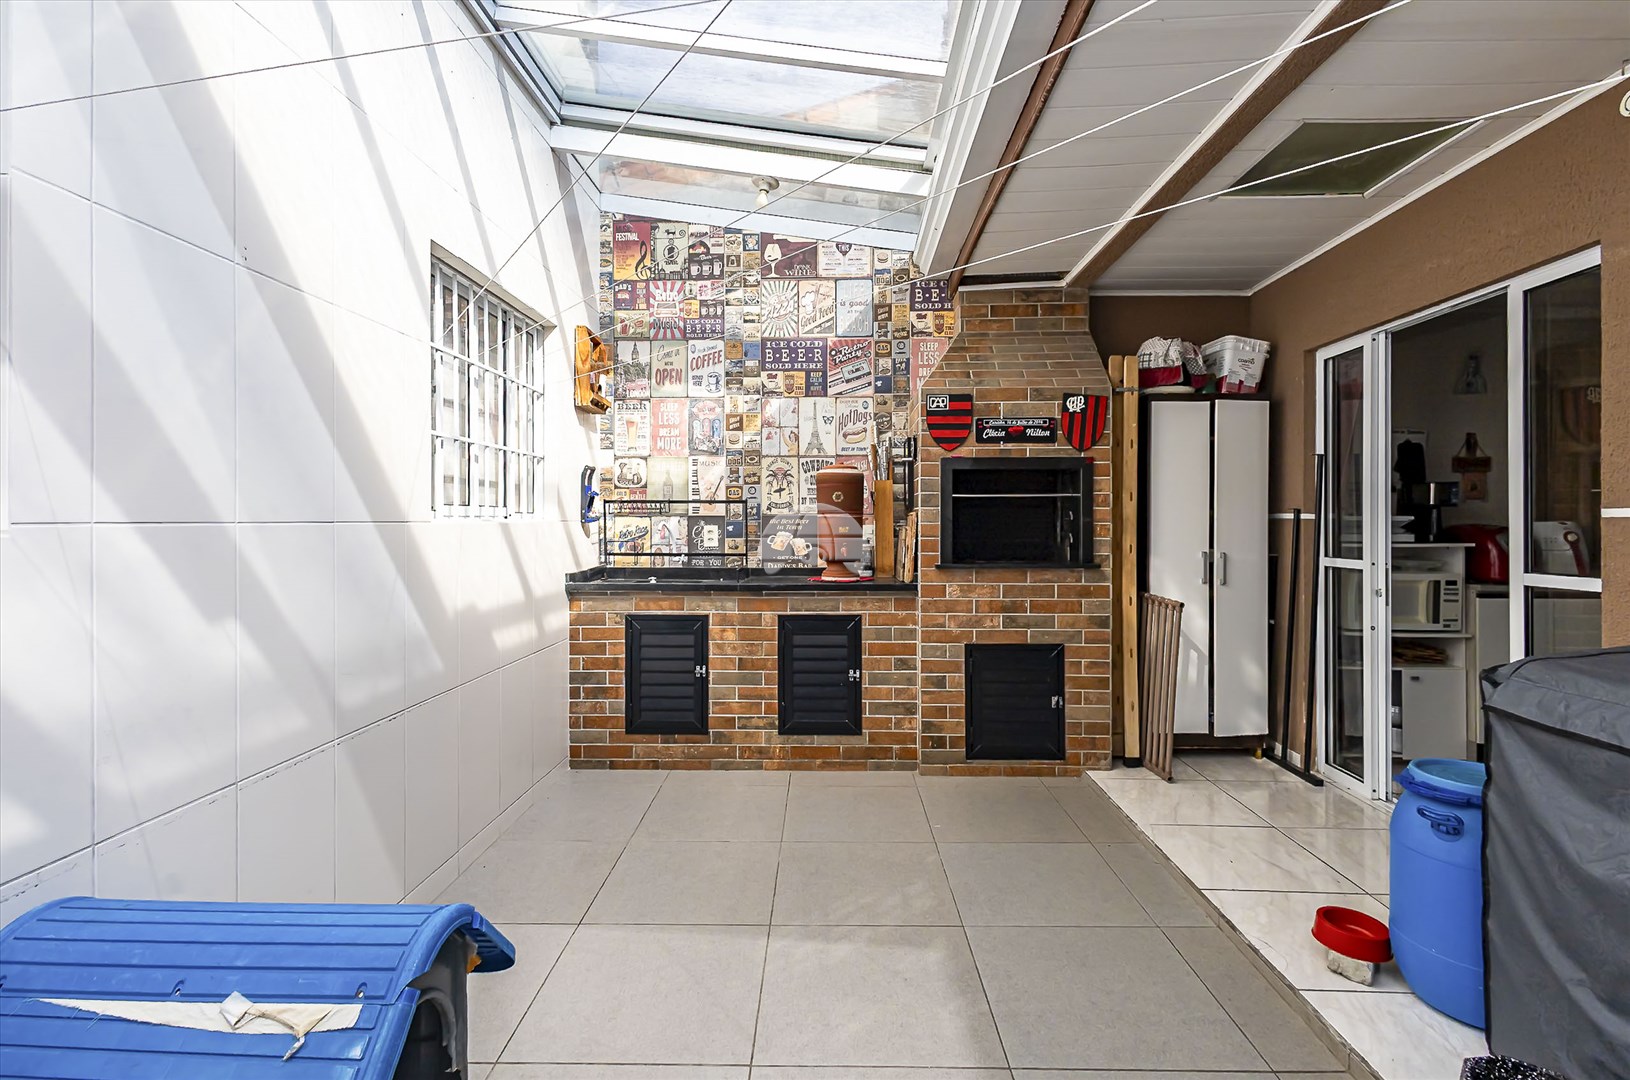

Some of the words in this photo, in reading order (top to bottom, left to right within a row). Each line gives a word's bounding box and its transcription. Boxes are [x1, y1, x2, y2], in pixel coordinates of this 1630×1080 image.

[615, 232, 640, 241] FESTIVAL
[914, 280, 937, 288] ICE
[766, 340, 788, 348] ICE
[790, 340, 823, 348] COLD
[839, 340, 870, 355] Retro
[919, 342, 940, 351] SLEEP
[689, 349, 723, 372] COFFEE
[833, 349, 864, 364] Party
[918, 352, 940, 365] LESS
[655, 368, 683, 386] OPEN
[658, 413, 680, 425] LESS
[658, 428, 680, 437] DREAM
[657, 437, 682, 450] MORE
[708, 558, 722, 566] YOU
